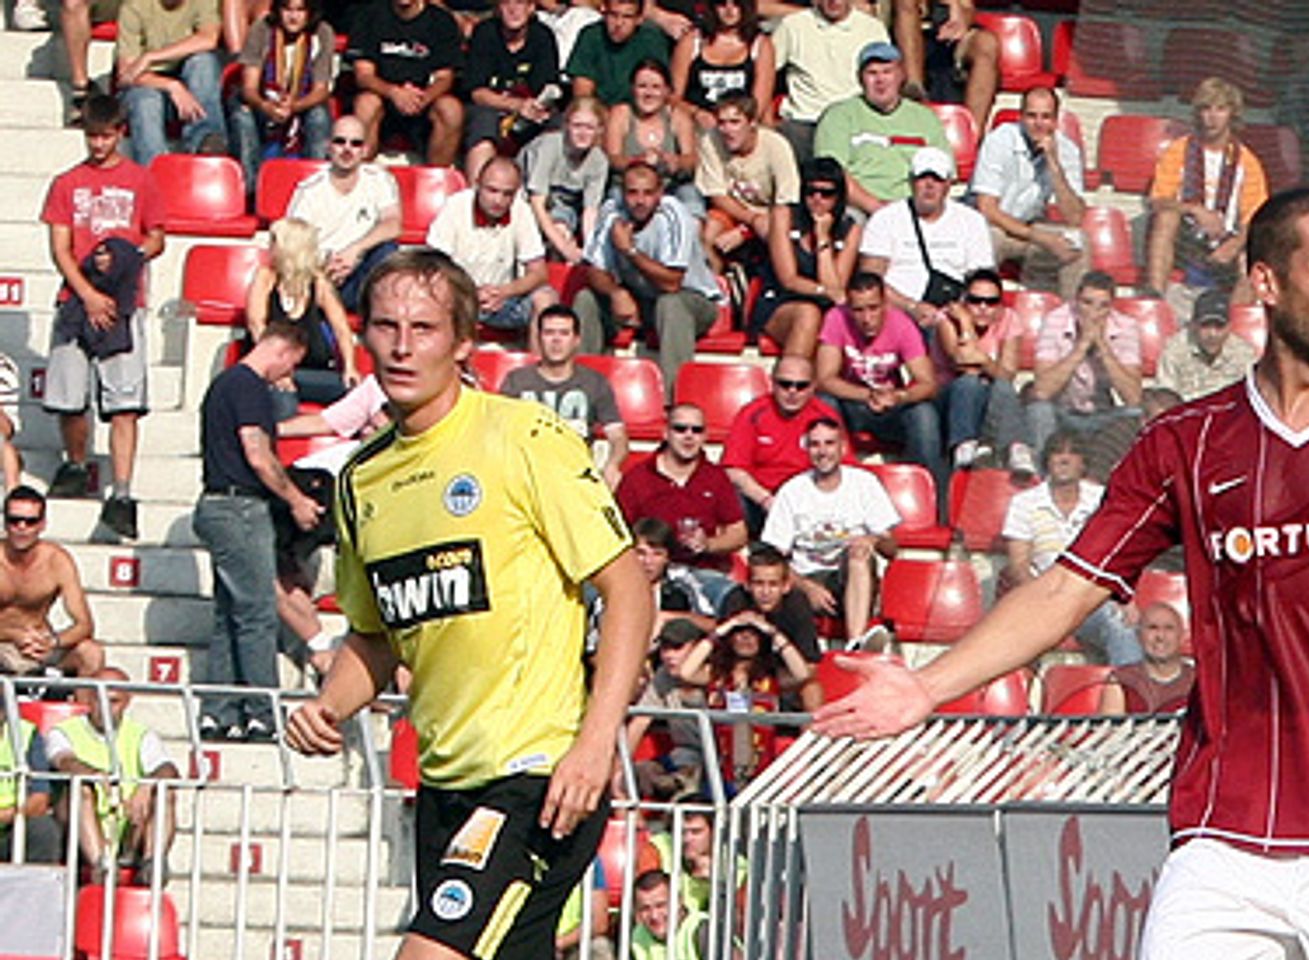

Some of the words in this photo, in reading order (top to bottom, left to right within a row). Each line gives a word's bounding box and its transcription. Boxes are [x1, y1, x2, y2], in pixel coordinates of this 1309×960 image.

[116, 563, 133, 582] 8
[373, 566, 471, 622] bwin
[157, 663, 172, 682] 7
